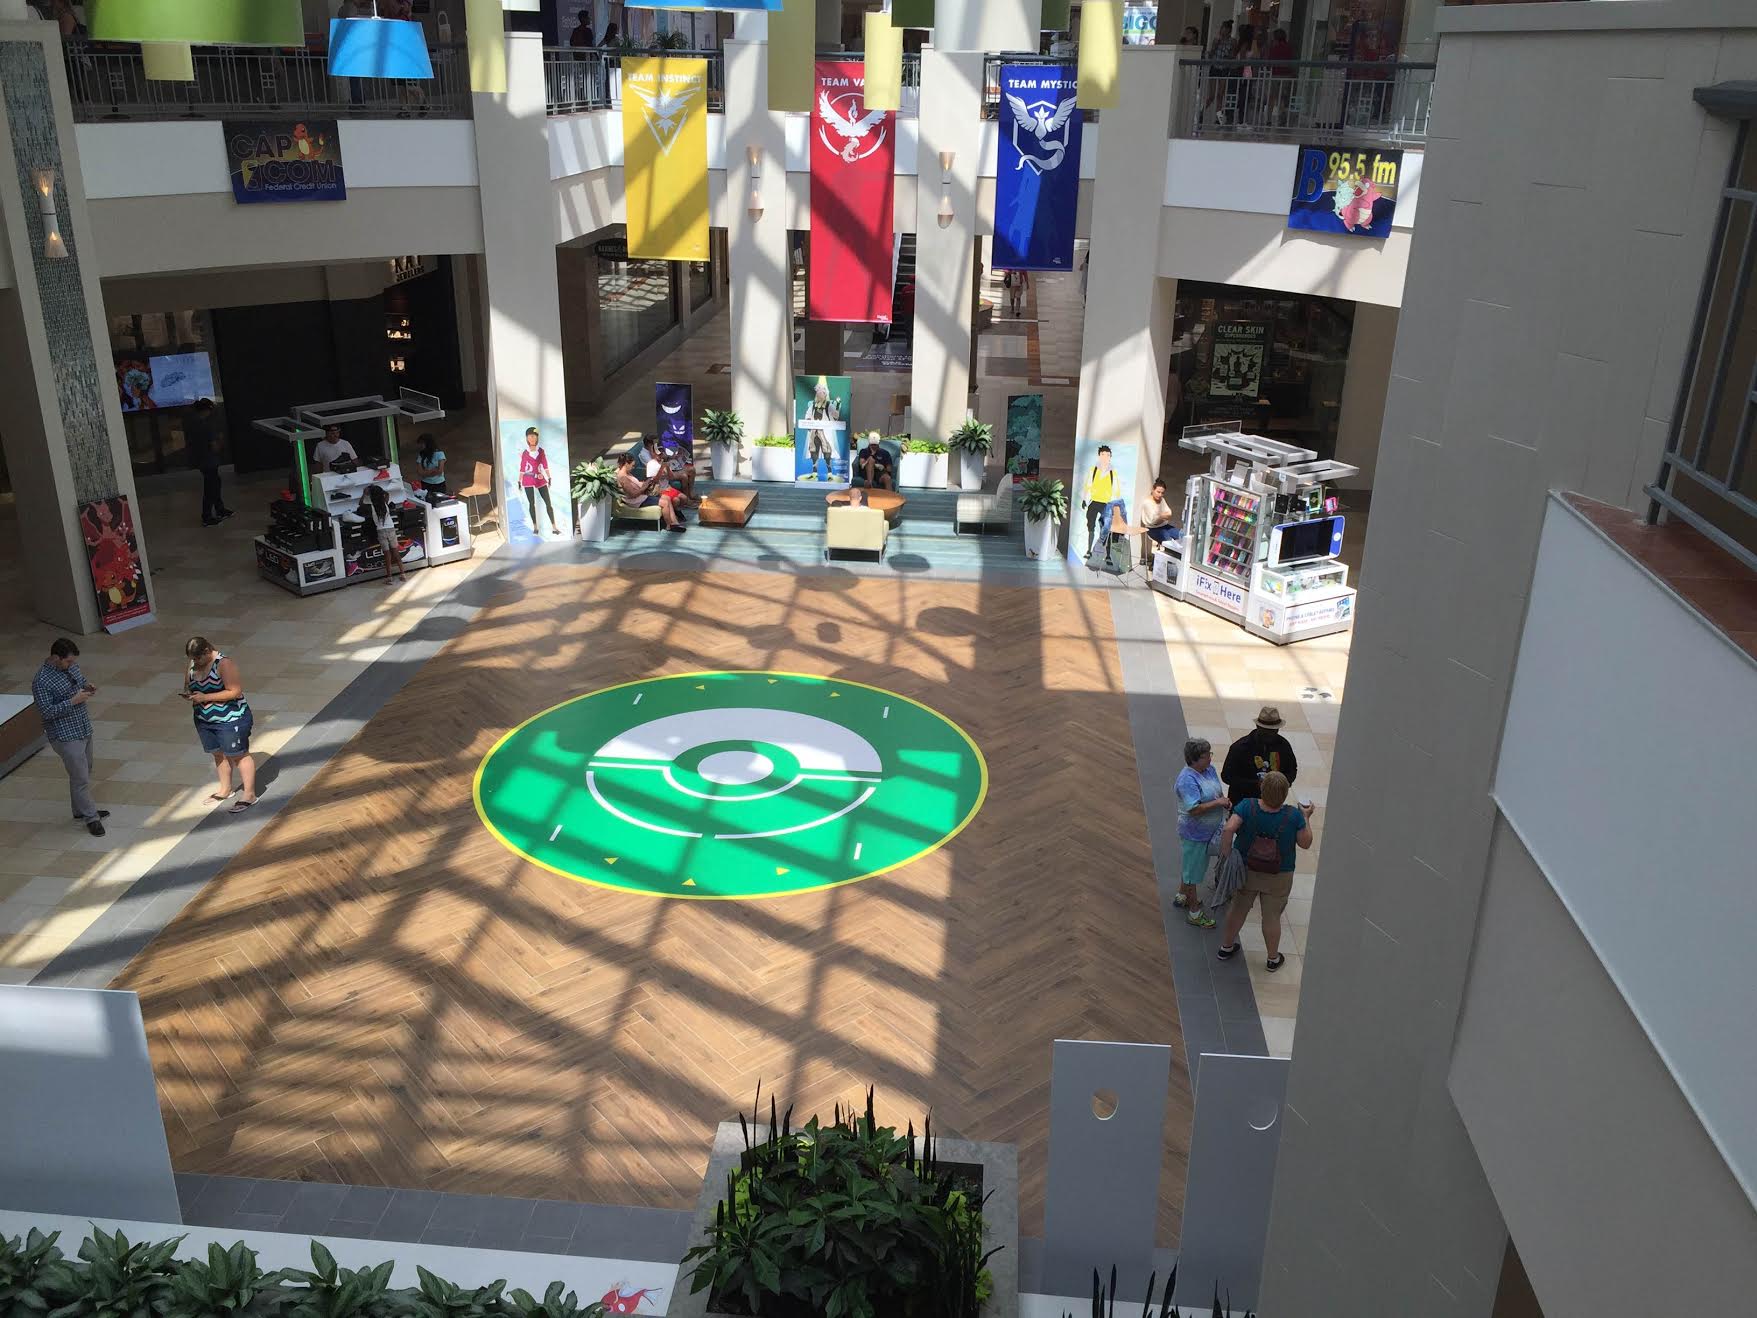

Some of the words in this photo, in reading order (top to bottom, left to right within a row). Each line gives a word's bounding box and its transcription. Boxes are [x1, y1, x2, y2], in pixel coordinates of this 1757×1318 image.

[628, 73, 654, 82] TEAM
[821, 77, 849, 87] TEAM
[1008, 79, 1037, 89] TEAM
[1040, 80, 1078, 89] MYSTIC
[231, 134, 292, 159] CAP
[263, 160, 336, 183] COM
[1293, 149, 1327, 202] B
[1329, 152, 1366, 180] 95.5
[1372, 154, 1397, 185] fm
[264, 183, 293, 191] Federal
[293, 182, 315, 190] Credit
[317, 181, 337, 189] Union
[1217, 325, 1242, 334] CLEAR
[1245, 326, 1264, 334] SKIN
[1196, 574, 1211, 591] iFix
[1219, 585, 1241, 604] Here
